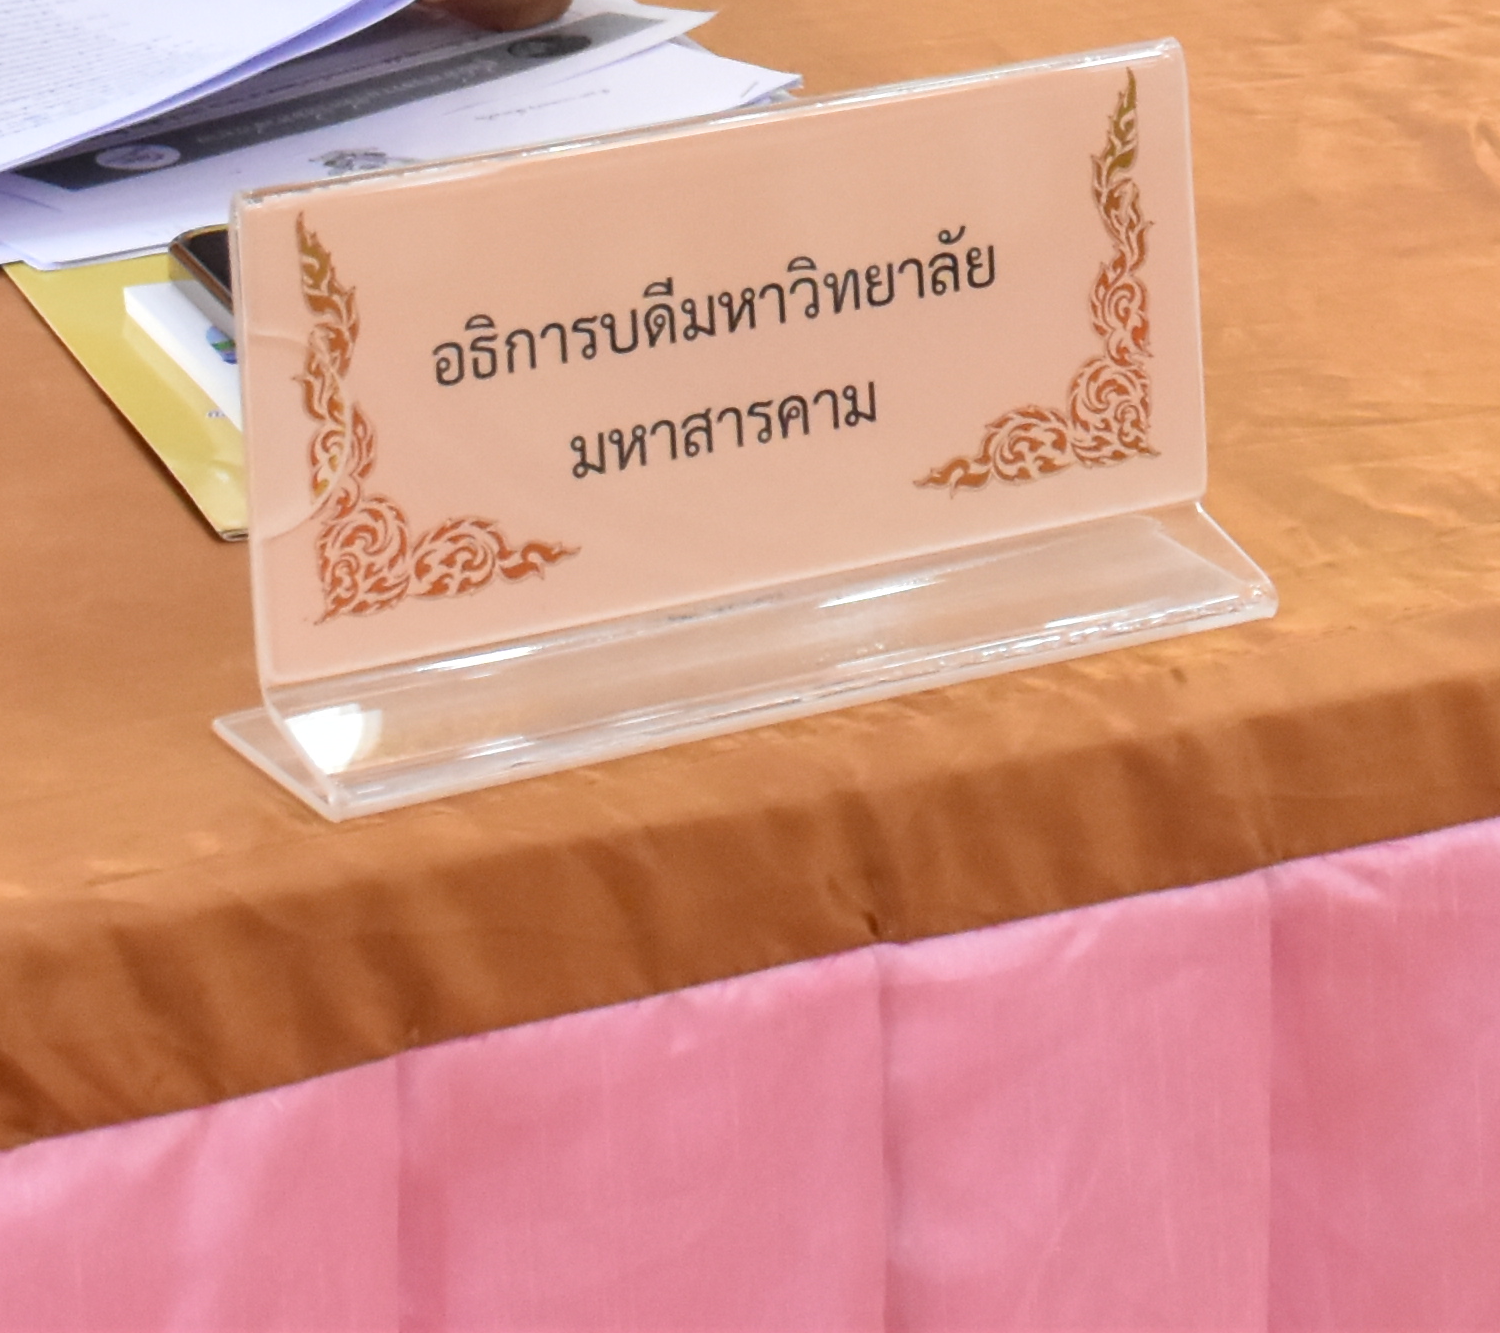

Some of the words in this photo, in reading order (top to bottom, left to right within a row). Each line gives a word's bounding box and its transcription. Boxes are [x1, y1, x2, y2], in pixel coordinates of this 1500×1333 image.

[432, 225, 997, 387] อธิการบดีมหาวิทยาลัย
[569, 380, 878, 480] มหาสารคาม
